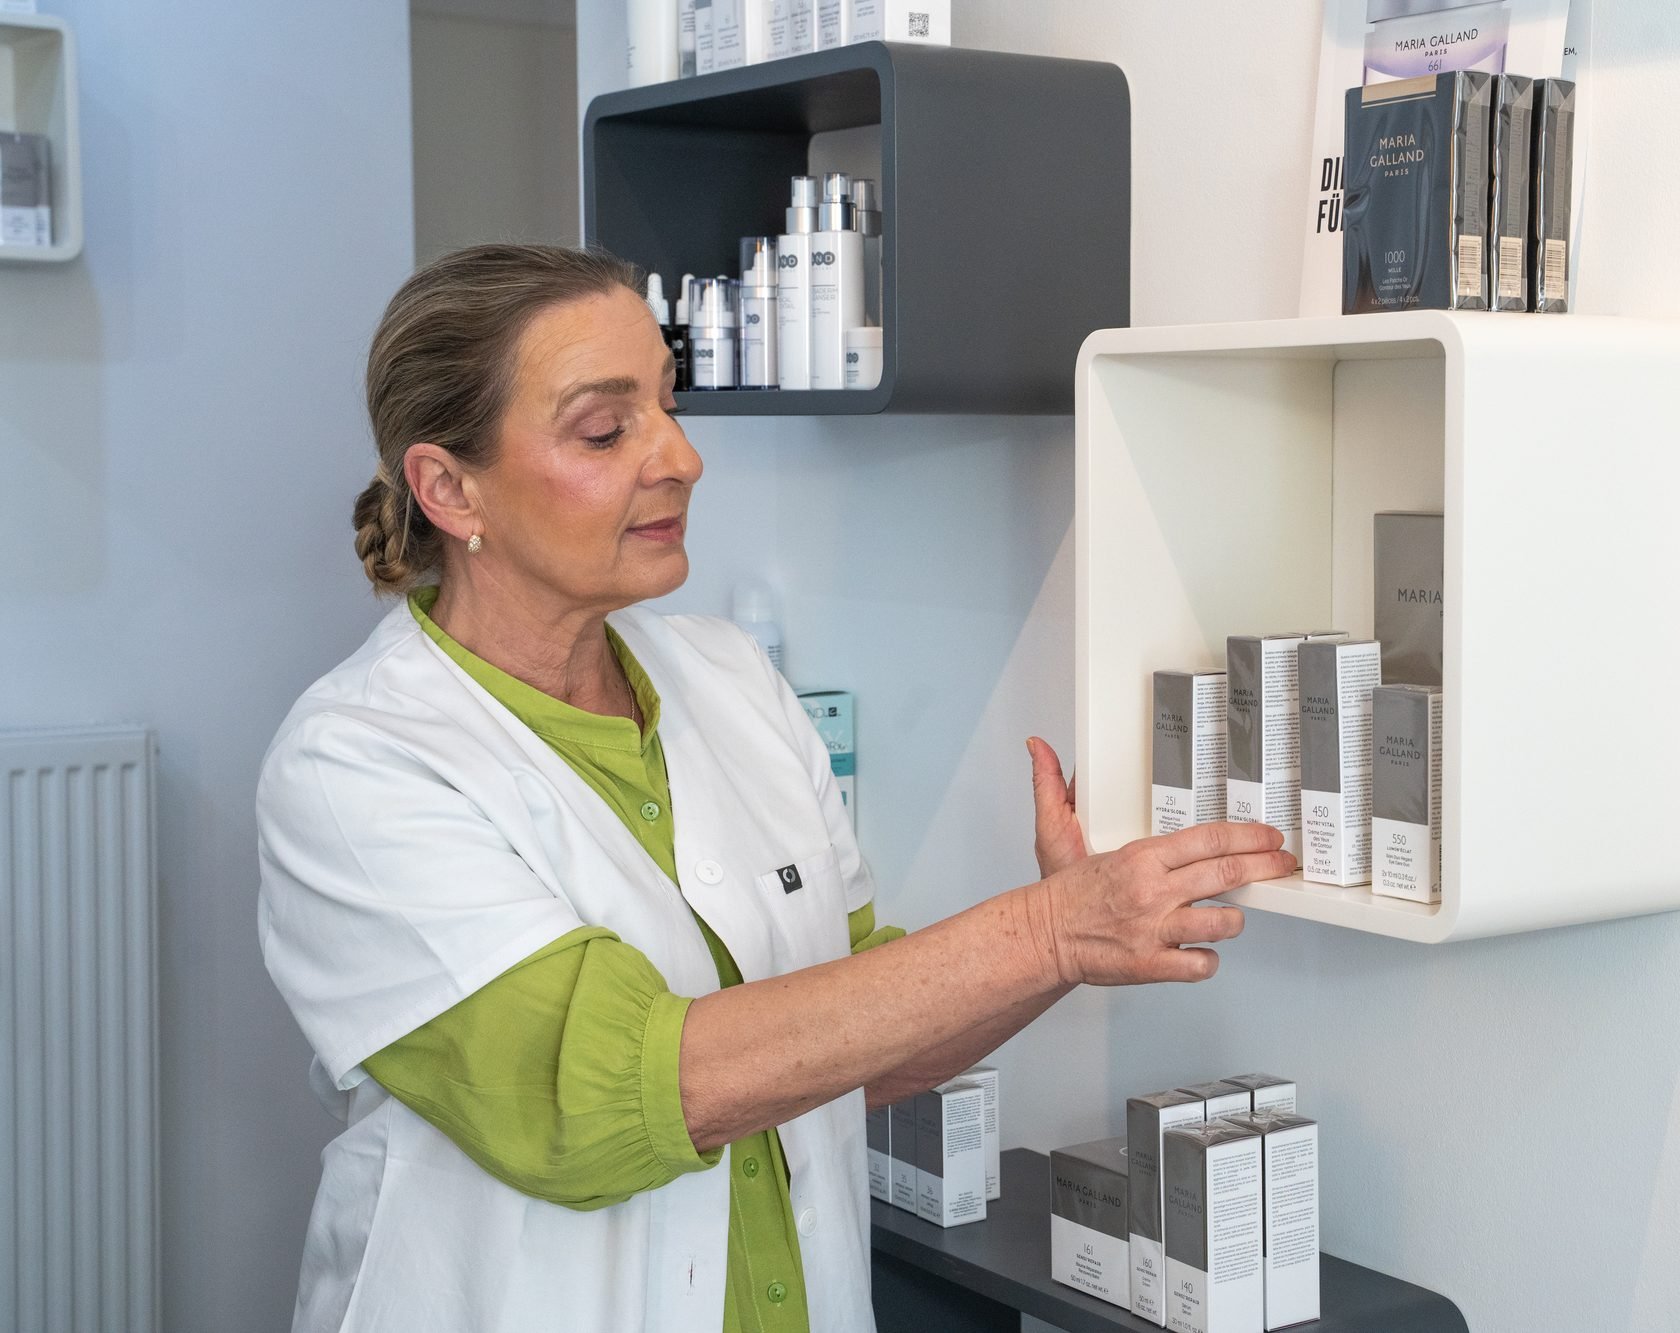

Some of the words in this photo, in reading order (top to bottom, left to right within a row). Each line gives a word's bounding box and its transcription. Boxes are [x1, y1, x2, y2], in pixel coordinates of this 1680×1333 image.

[1395, 38, 1426, 52] MARIA
[1430, 28, 1478, 47] GALLAND
[1425, 49, 1447, 57] PARIS
[1428, 60, 1442, 71] 661
[1380, 134, 1415, 150] MARIA
[1370, 150, 1424, 167] GALLAND
[1384, 168, 1408, 176] PARIS
[1317, 193, 1343, 233] FÜ
[1385, 250, 1405, 263] 1000
[1398, 588, 1442, 604] MARIA
[1234, 689, 1253, 697] MARIA
[1229, 698, 1258, 707] GALLAND
[1307, 697, 1329, 705] MARIA
[1302, 705, 1334, 714] GALLAND
[1161, 713, 1183, 722] MARIA
[1156, 722, 1188, 733] GALLAND
[1386, 736, 1414, 747] MARIA
[1380, 746, 1420, 760] GALLAND
[1166, 796, 1176, 806] 251
[1237, 801, 1251, 813] 250
[1312, 806, 1328, 818] 450
[1392, 834, 1406, 845] 550
[1056, 1177, 1080, 1193] MARIA
[1082, 1186, 1121, 1208] GALLAND
[1175, 1185, 1197, 1201] MARIA
[1169, 1195, 1202, 1214] GALLAND
[1084, 1243, 1093, 1255] 161
[1142, 1257, 1152, 1268] 160
[1181, 1280, 1193, 1294] 140
